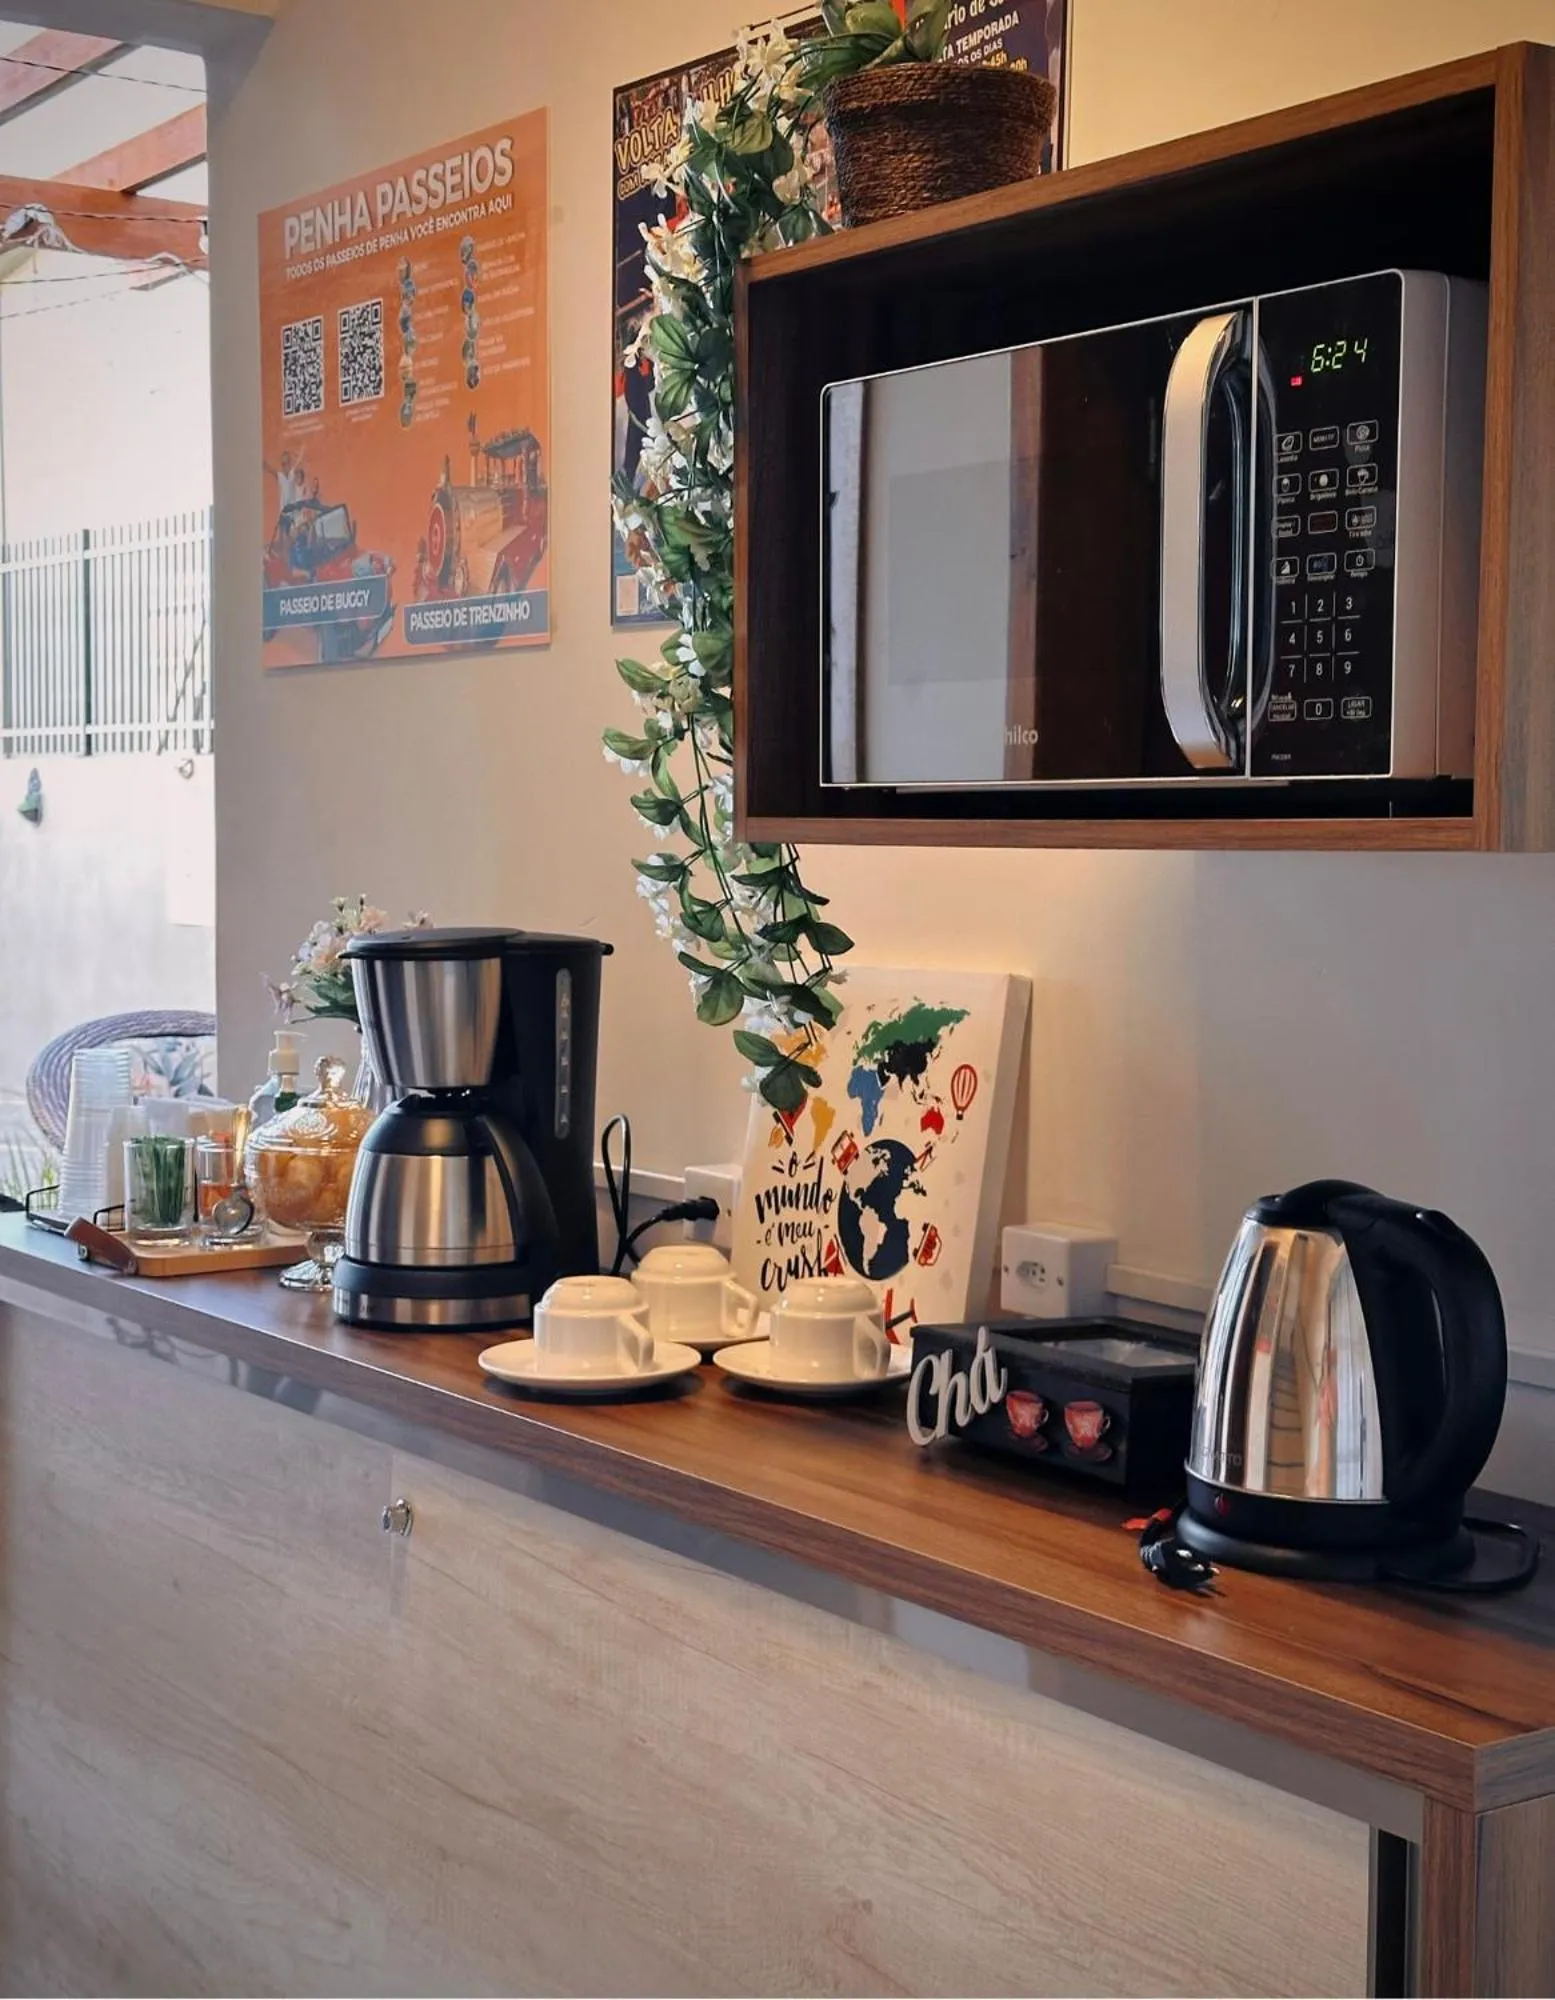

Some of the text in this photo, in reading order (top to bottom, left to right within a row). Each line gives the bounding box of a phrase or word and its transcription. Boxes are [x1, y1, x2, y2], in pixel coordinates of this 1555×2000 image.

[944, 3, 966, 29] rio
[956, 10, 1020, 55] TEMPORADA
[970, 48, 982, 63] OS
[983, 37, 1003, 56] DIAS
[616, 108, 680, 172] VOLTA
[285, 137, 513, 259] PENHA PASSEIOS
[285, 193, 513, 280] TODOS OS PASSEIOS DE PENHA VOCÊ ENCONTRA AQUI
[1310, 338, 1368, 373] 6:24
[279, 589, 371, 616] PASSEIO DE BUGGY
[410, 602, 531, 632] PASSEIO DE TRENZINHO
[1316, 598, 1324, 612] 2
[1345, 596, 1353, 610] 3
[1289, 628, 1352, 645] 4 5 6
[1289, 661, 1352, 678] 7 8 9
[1315, 702, 1323, 716] 0
[1003, 724, 1039, 745] hilco
[755, 1155, 837, 1224] mundo
[777, 1219, 816, 1248] meu
[760, 1230, 829, 1292] crush
[907, 1326, 1008, 1447] Chá
